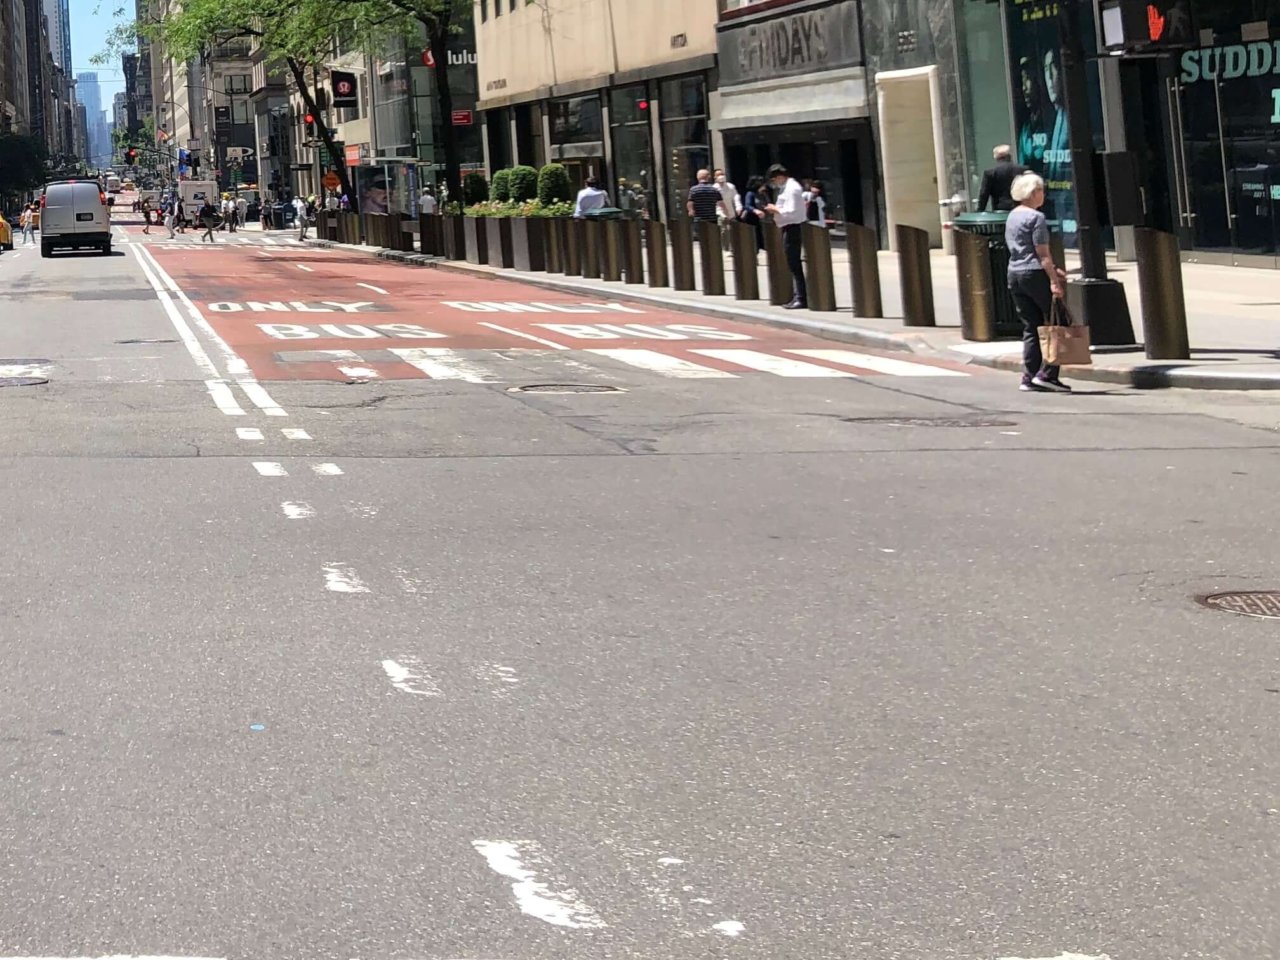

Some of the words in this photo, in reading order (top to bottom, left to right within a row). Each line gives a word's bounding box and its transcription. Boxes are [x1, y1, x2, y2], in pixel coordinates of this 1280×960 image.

[1180, 40, 1280, 83] SUDD
[1032, 132, 1048, 147] NO
[208, 301, 374, 313] ONLY
[440, 301, 646, 313] ONLY
[256, 323, 449, 339] BUS
[530, 323, 753, 340] BUS
